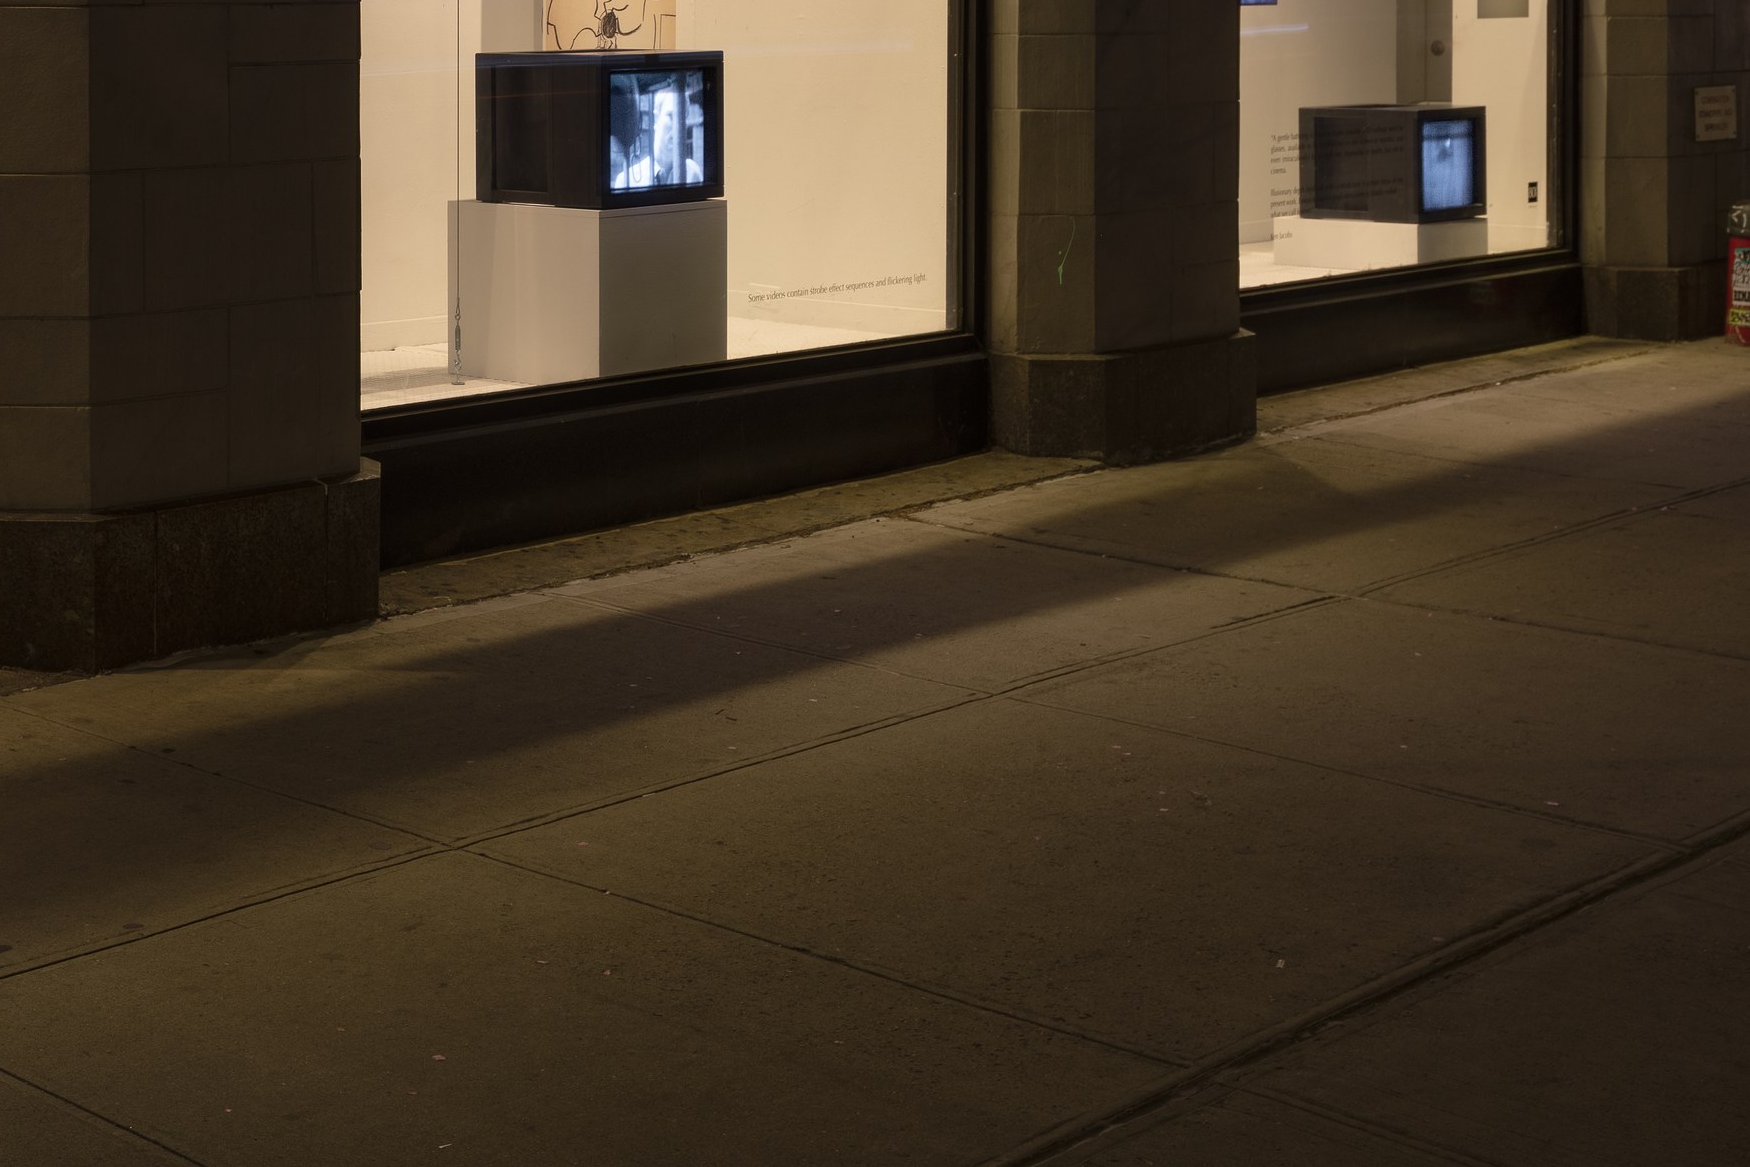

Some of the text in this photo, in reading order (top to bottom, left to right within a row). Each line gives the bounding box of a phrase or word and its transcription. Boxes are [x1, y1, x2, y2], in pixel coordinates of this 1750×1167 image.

[748, 294, 765, 303] Some
[766, 290, 786, 300] videos
[786, 288, 809, 298] contain
[809, 284, 827, 296] strobe
[828, 283, 845, 294] effect
[845, 281, 874, 292] sequences
[875, 277, 887, 287] and
[887, 275, 913, 286] flickering
